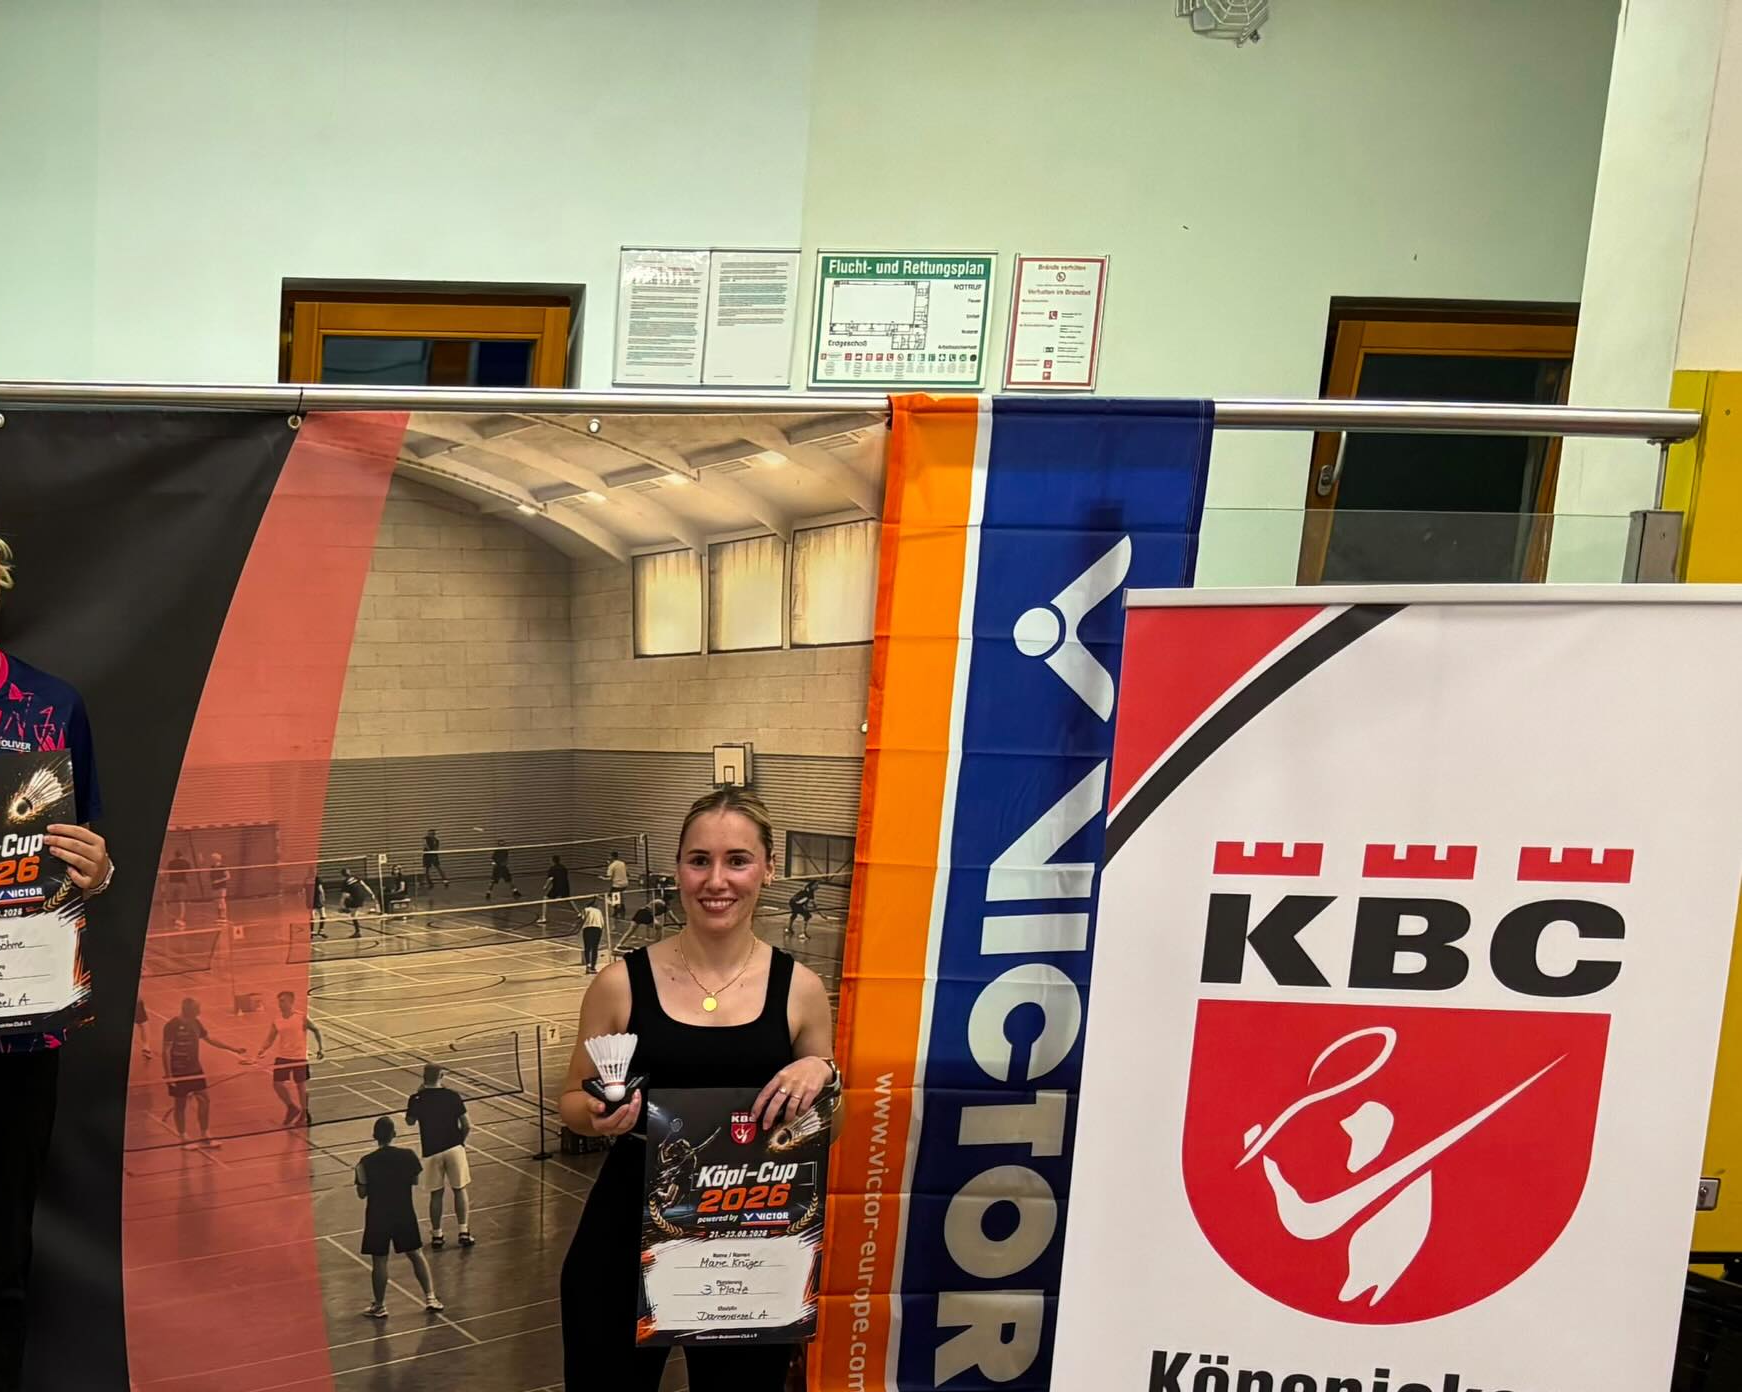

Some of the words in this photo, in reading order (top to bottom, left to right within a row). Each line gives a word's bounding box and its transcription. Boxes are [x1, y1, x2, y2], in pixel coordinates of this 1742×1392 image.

[829, 259, 872, 274] Flucht-
[876, 260, 899, 274] und
[903, 260, 984, 277] Rettungsplan
[0, 740, 31, 750] OLIVER
[6, 887, 43, 899] VICTOR
[1200, 893, 1627, 998] KBC
[18, 993, 31, 1006] A
[934, 758, 1106, 1389] VICTOR
[696, 1161, 799, 1190] Köpi-Cup
[697, 1183, 791, 1213] 2026
[697, 1214, 728, 1224] powered
[729, 1213, 739, 1222] by
[755, 1211, 789, 1220] VICTOR
[700, 1284, 713, 1296] 3
[758, 1309, 769, 1320] A
